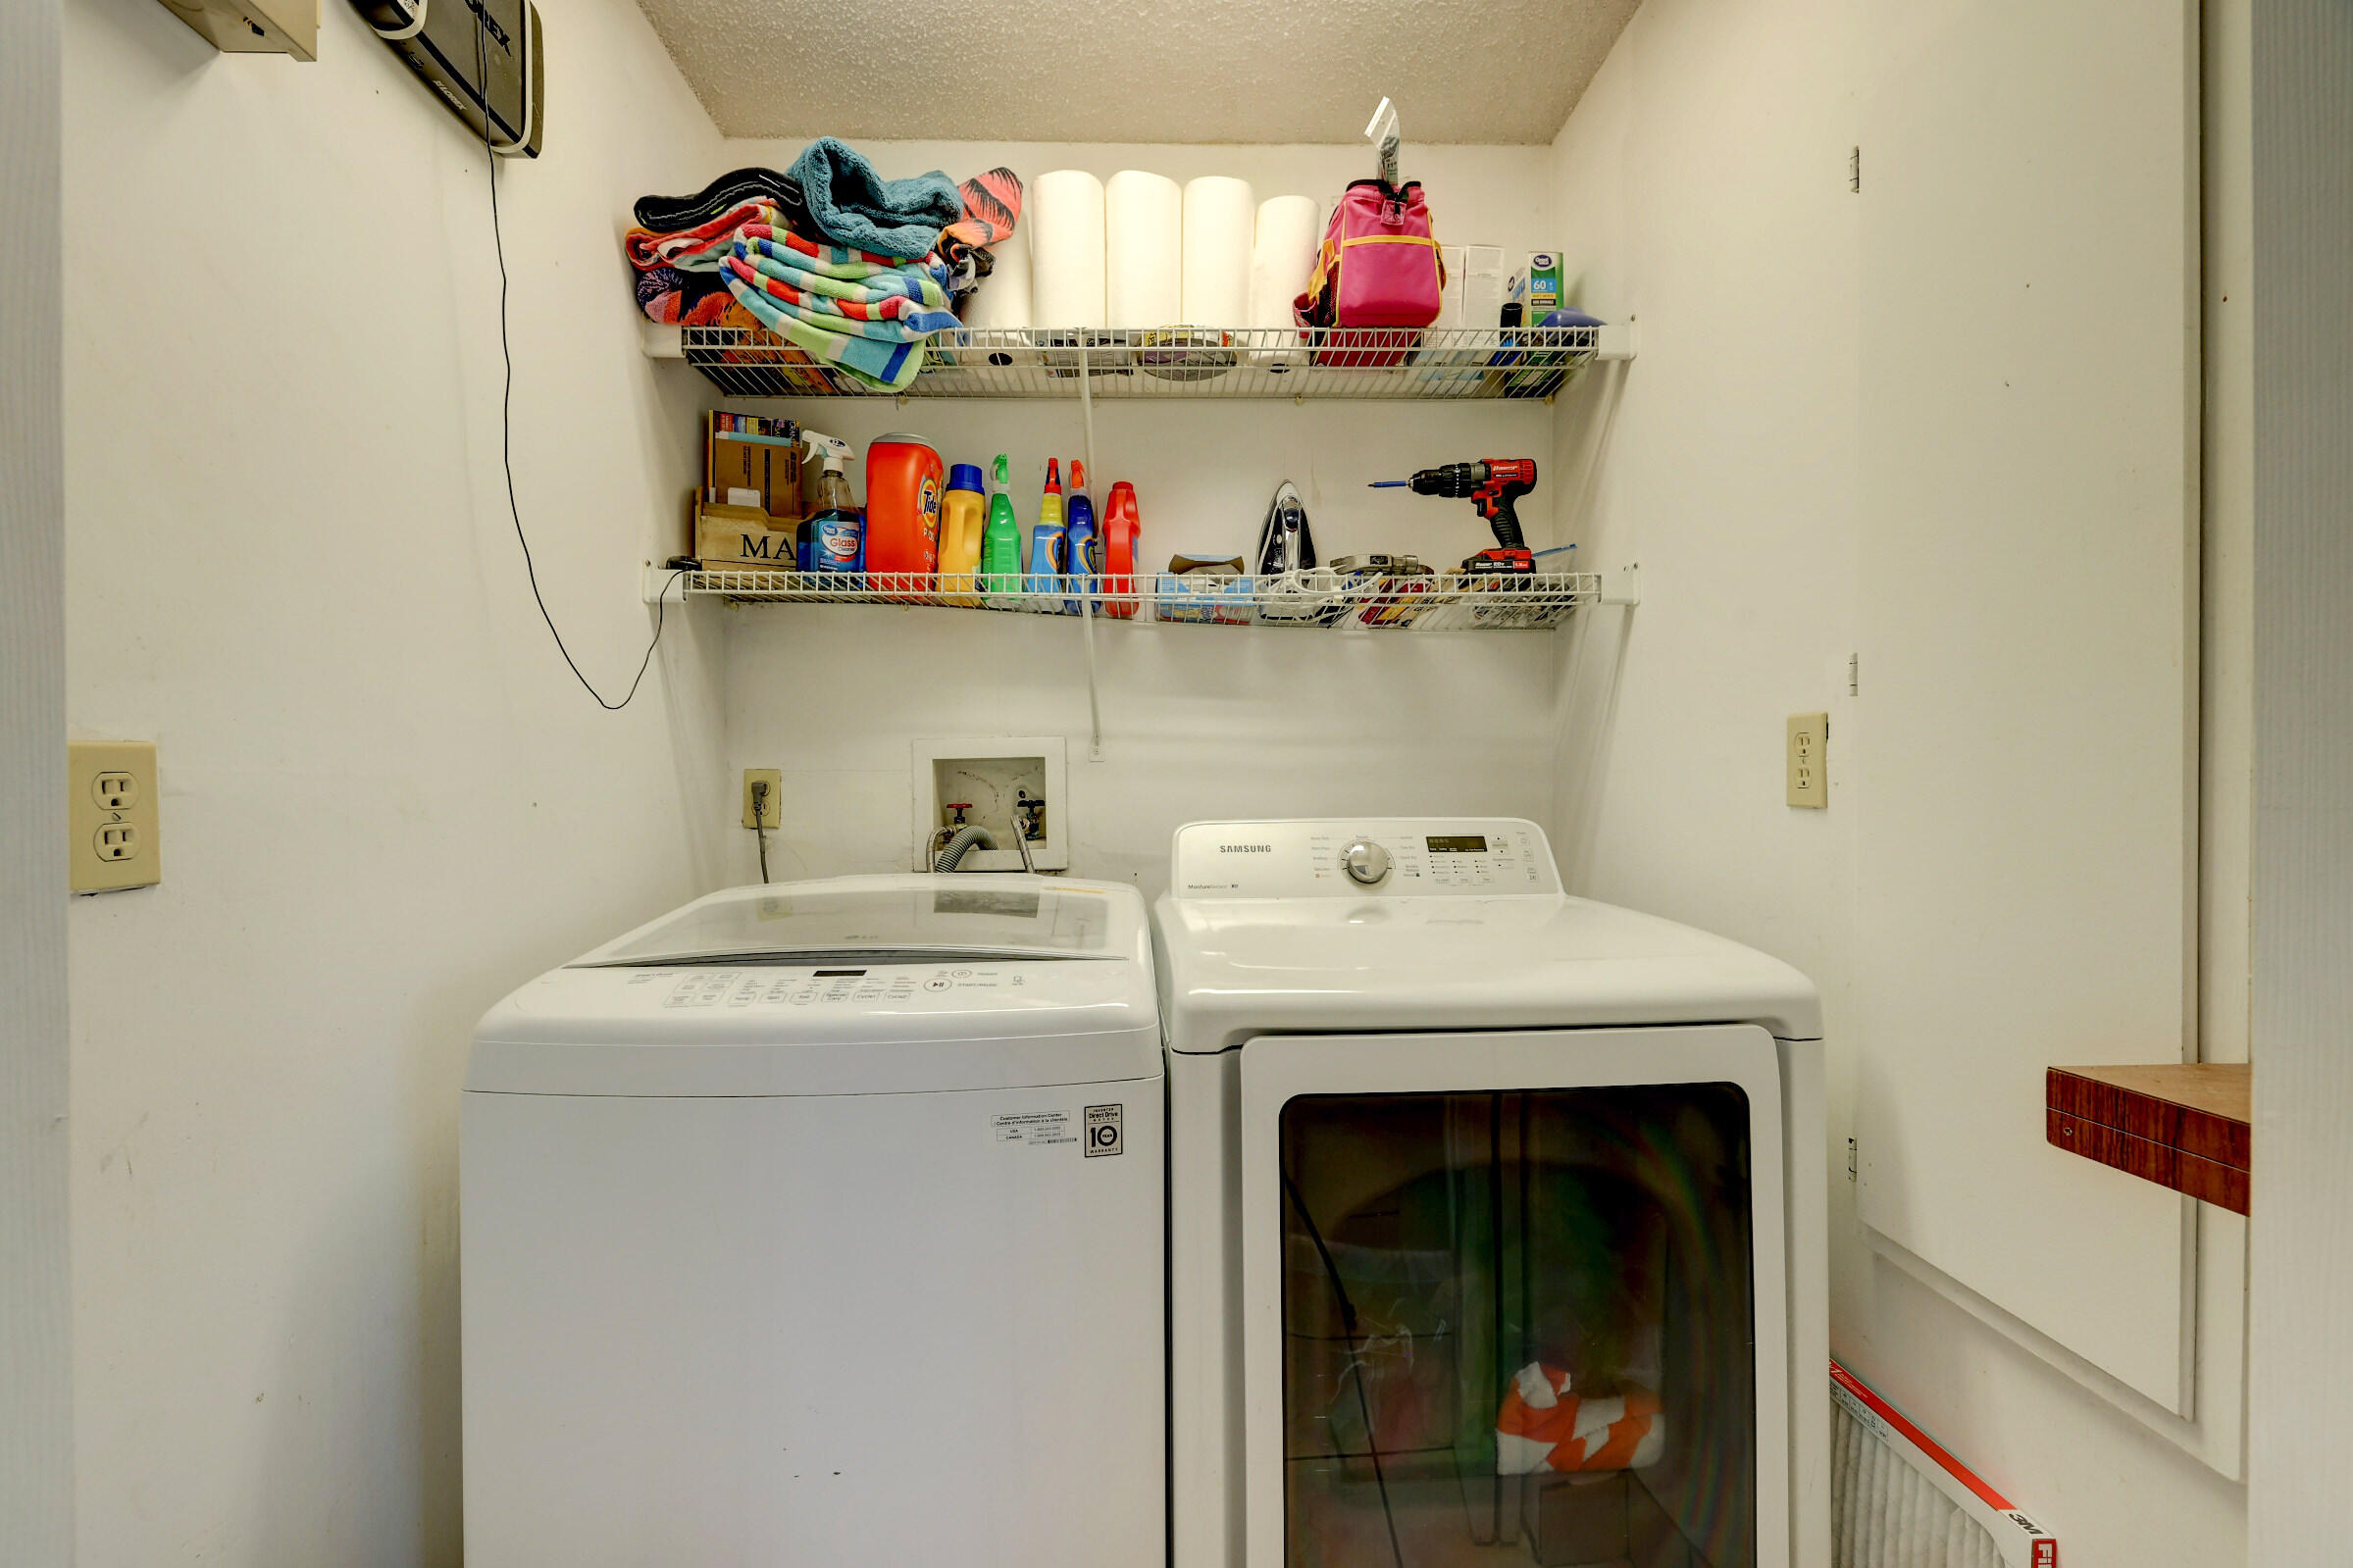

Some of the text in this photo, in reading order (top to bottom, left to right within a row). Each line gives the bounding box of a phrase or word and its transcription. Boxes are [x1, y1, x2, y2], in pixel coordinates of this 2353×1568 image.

[1533, 280, 1547, 290] 60
[924, 490, 937, 514] Tide
[830, 537, 855, 547] Glass
[1090, 1125, 1118, 1147] 10
[2008, 1513, 2043, 1535] 3M
